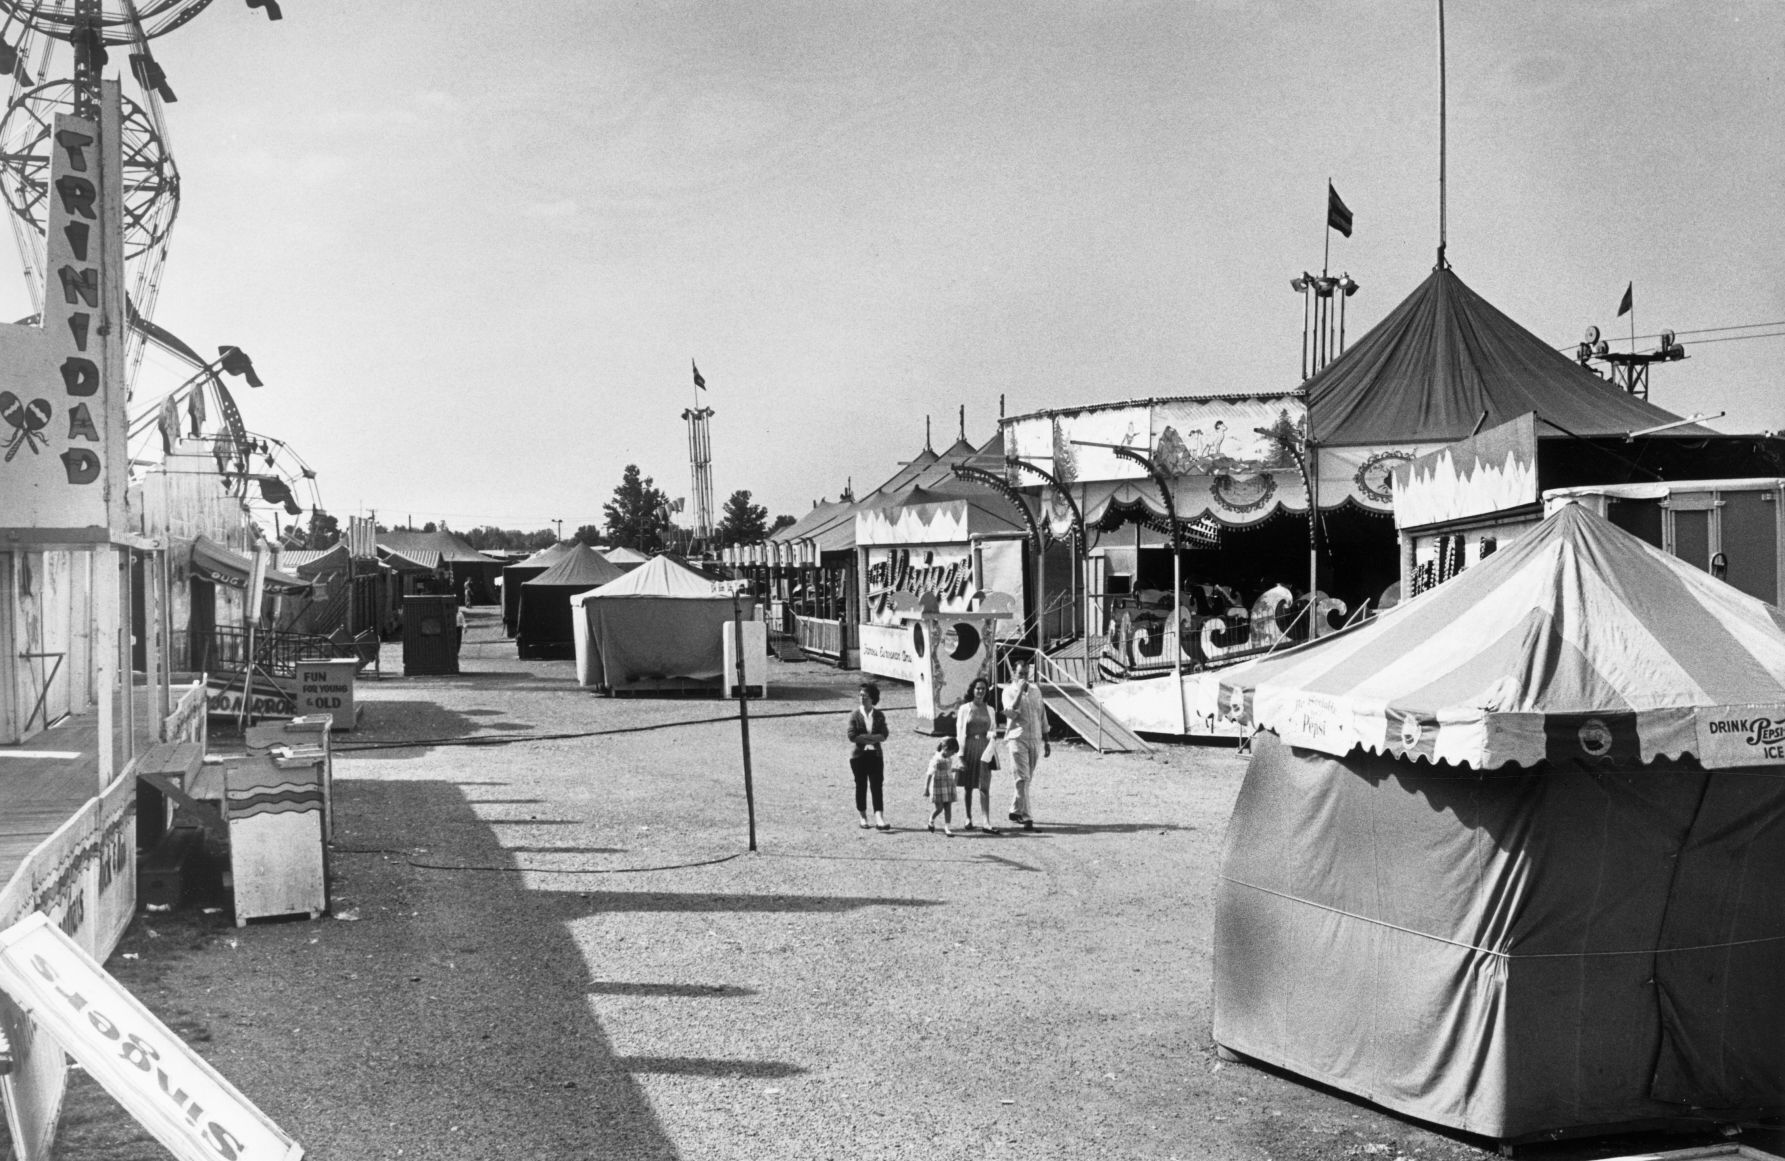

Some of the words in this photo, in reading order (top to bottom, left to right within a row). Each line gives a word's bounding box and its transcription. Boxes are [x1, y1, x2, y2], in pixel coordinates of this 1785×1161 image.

[54, 129, 102, 486] TRINIDAD
[304, 671, 327, 682] FUN
[302, 684, 318, 693] FOR
[319, 684, 348, 694] YOUNG
[315, 697, 341, 709] OLD
[1303, 713, 1326, 738] Pepsi
[1709, 719, 1748, 734] DRINK
[1764, 746, 1784, 759] ICE
[30, 953, 245, 1161] Singers
